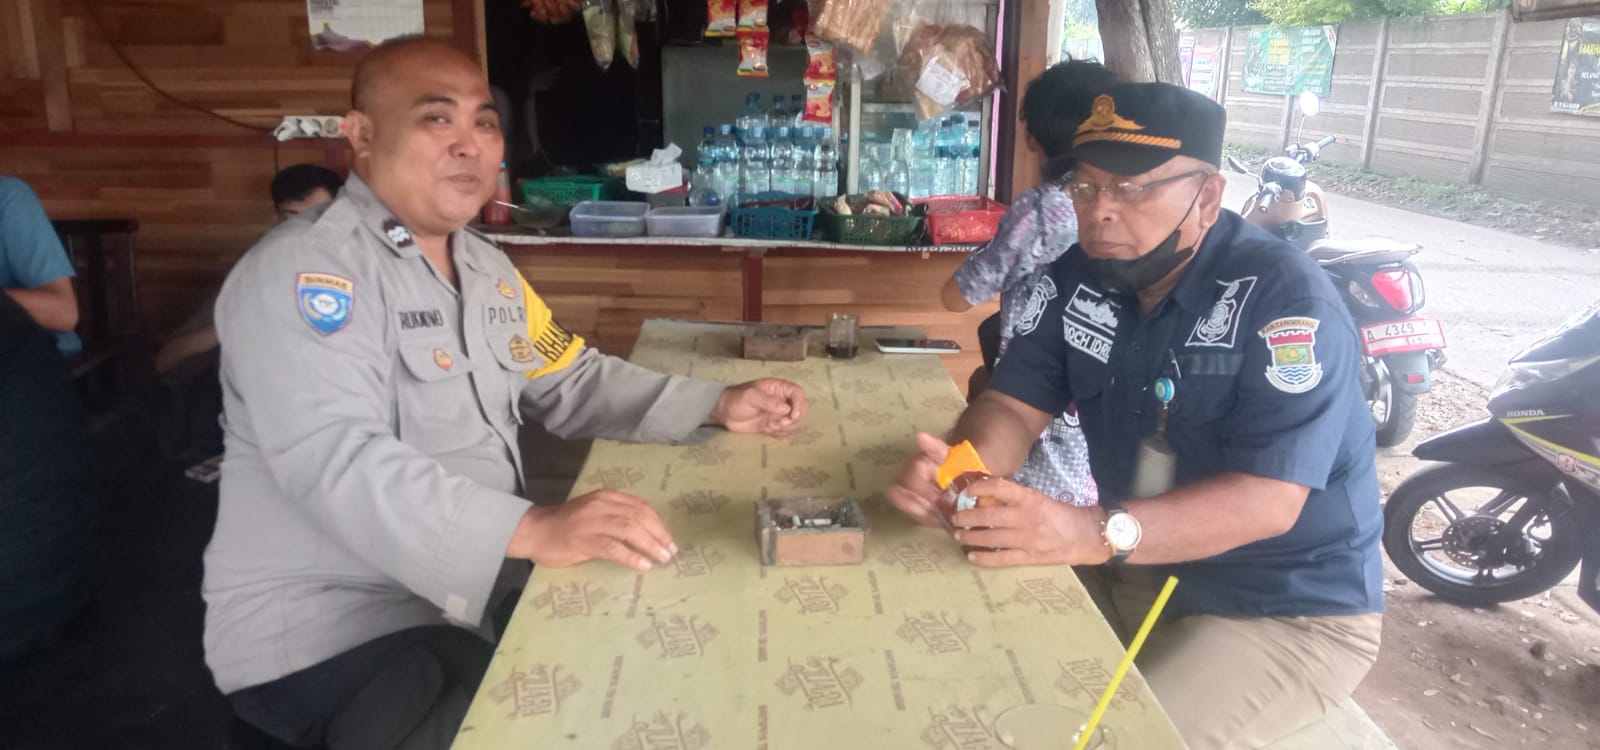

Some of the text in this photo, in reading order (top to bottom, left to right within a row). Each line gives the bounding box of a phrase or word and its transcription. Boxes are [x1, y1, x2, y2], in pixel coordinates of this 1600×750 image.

[1366, 322, 1415, 341] A 4349
[1506, 409, 1545, 417] HONDA
